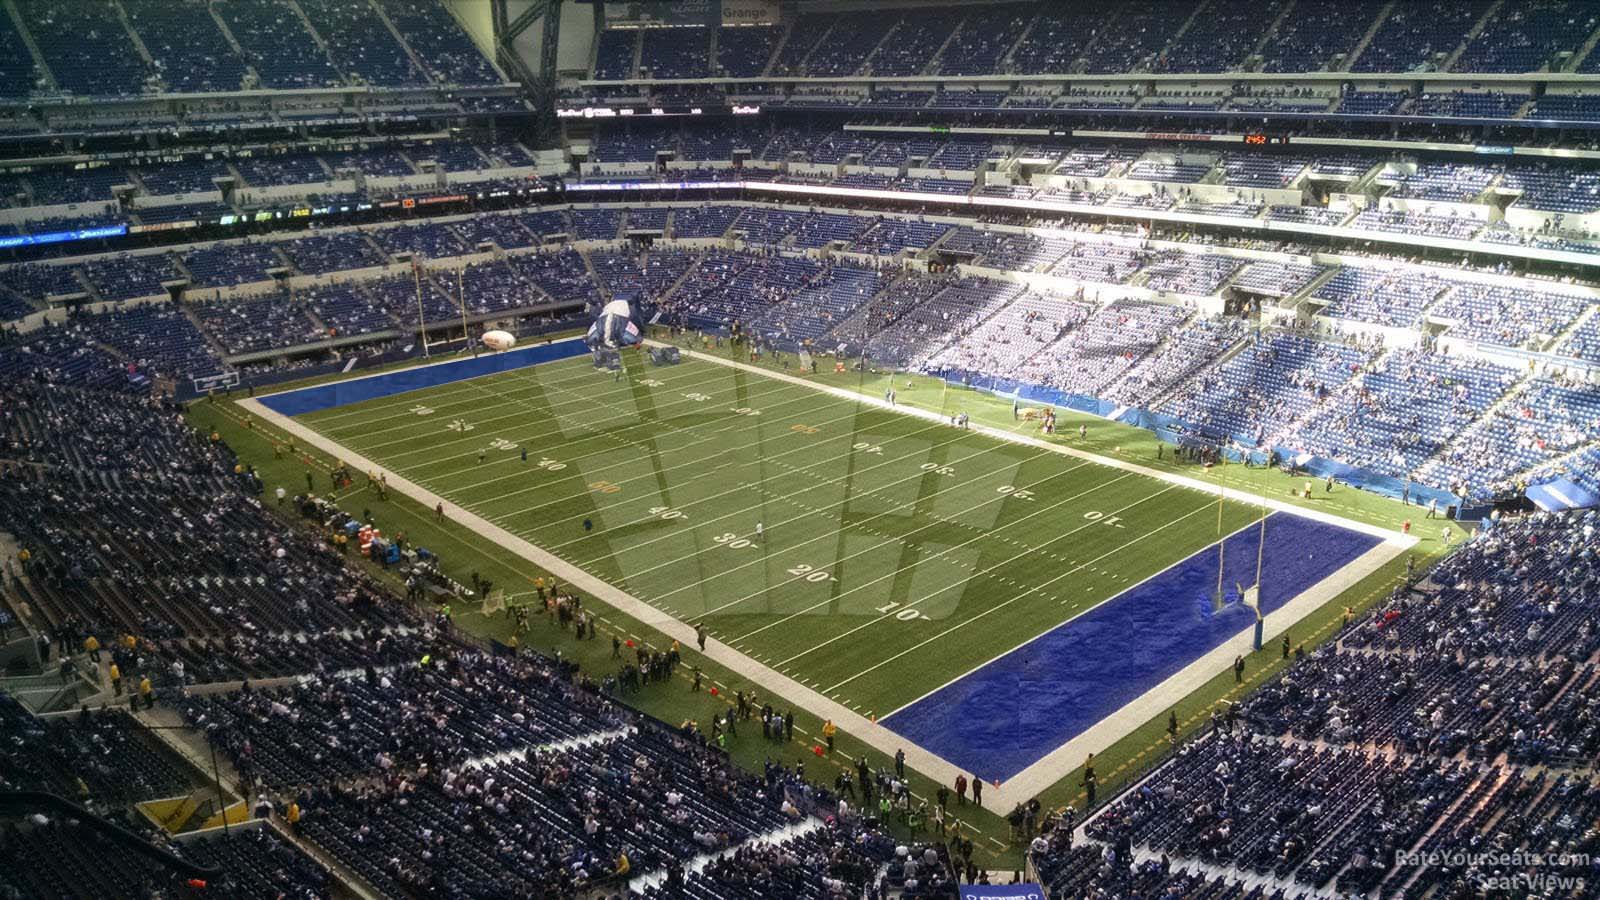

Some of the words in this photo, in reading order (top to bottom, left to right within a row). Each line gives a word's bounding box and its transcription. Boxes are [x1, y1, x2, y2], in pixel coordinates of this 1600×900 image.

[723, 7, 767, 19] Grange
[537, 458, 567, 471] 40
[648, 505, 682, 520] 40
[713, 532, 751, 549] 30
[787, 564, 829, 583] 20
[875, 601, 920, 622] 10
